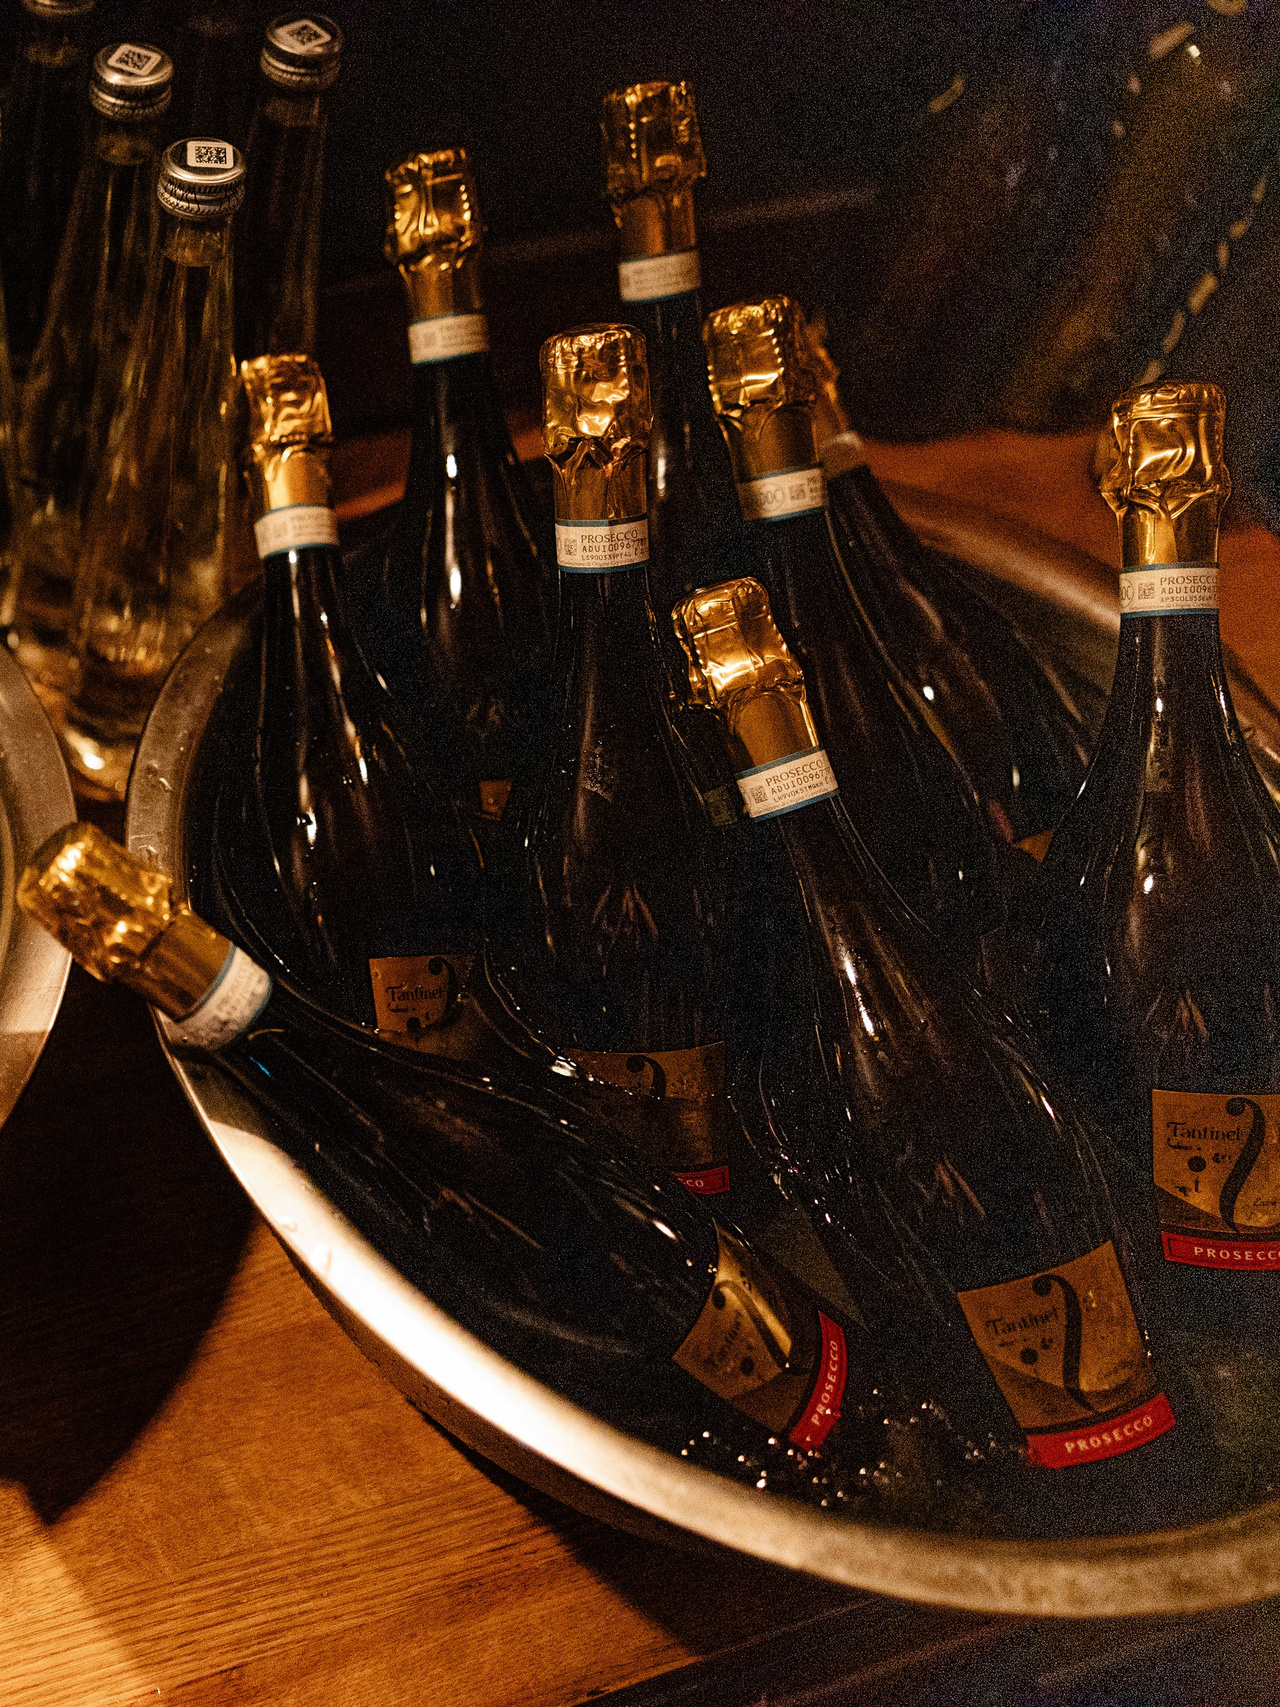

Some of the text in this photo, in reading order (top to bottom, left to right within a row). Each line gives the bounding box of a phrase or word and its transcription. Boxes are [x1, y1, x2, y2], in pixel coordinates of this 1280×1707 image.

[580, 529, 638, 543] PROSECCO
[765, 759, 823, 787] PROSECCO
[811, 1339, 839, 1427] PROSECCO
[1064, 1415, 1153, 1454] PROSECCO
